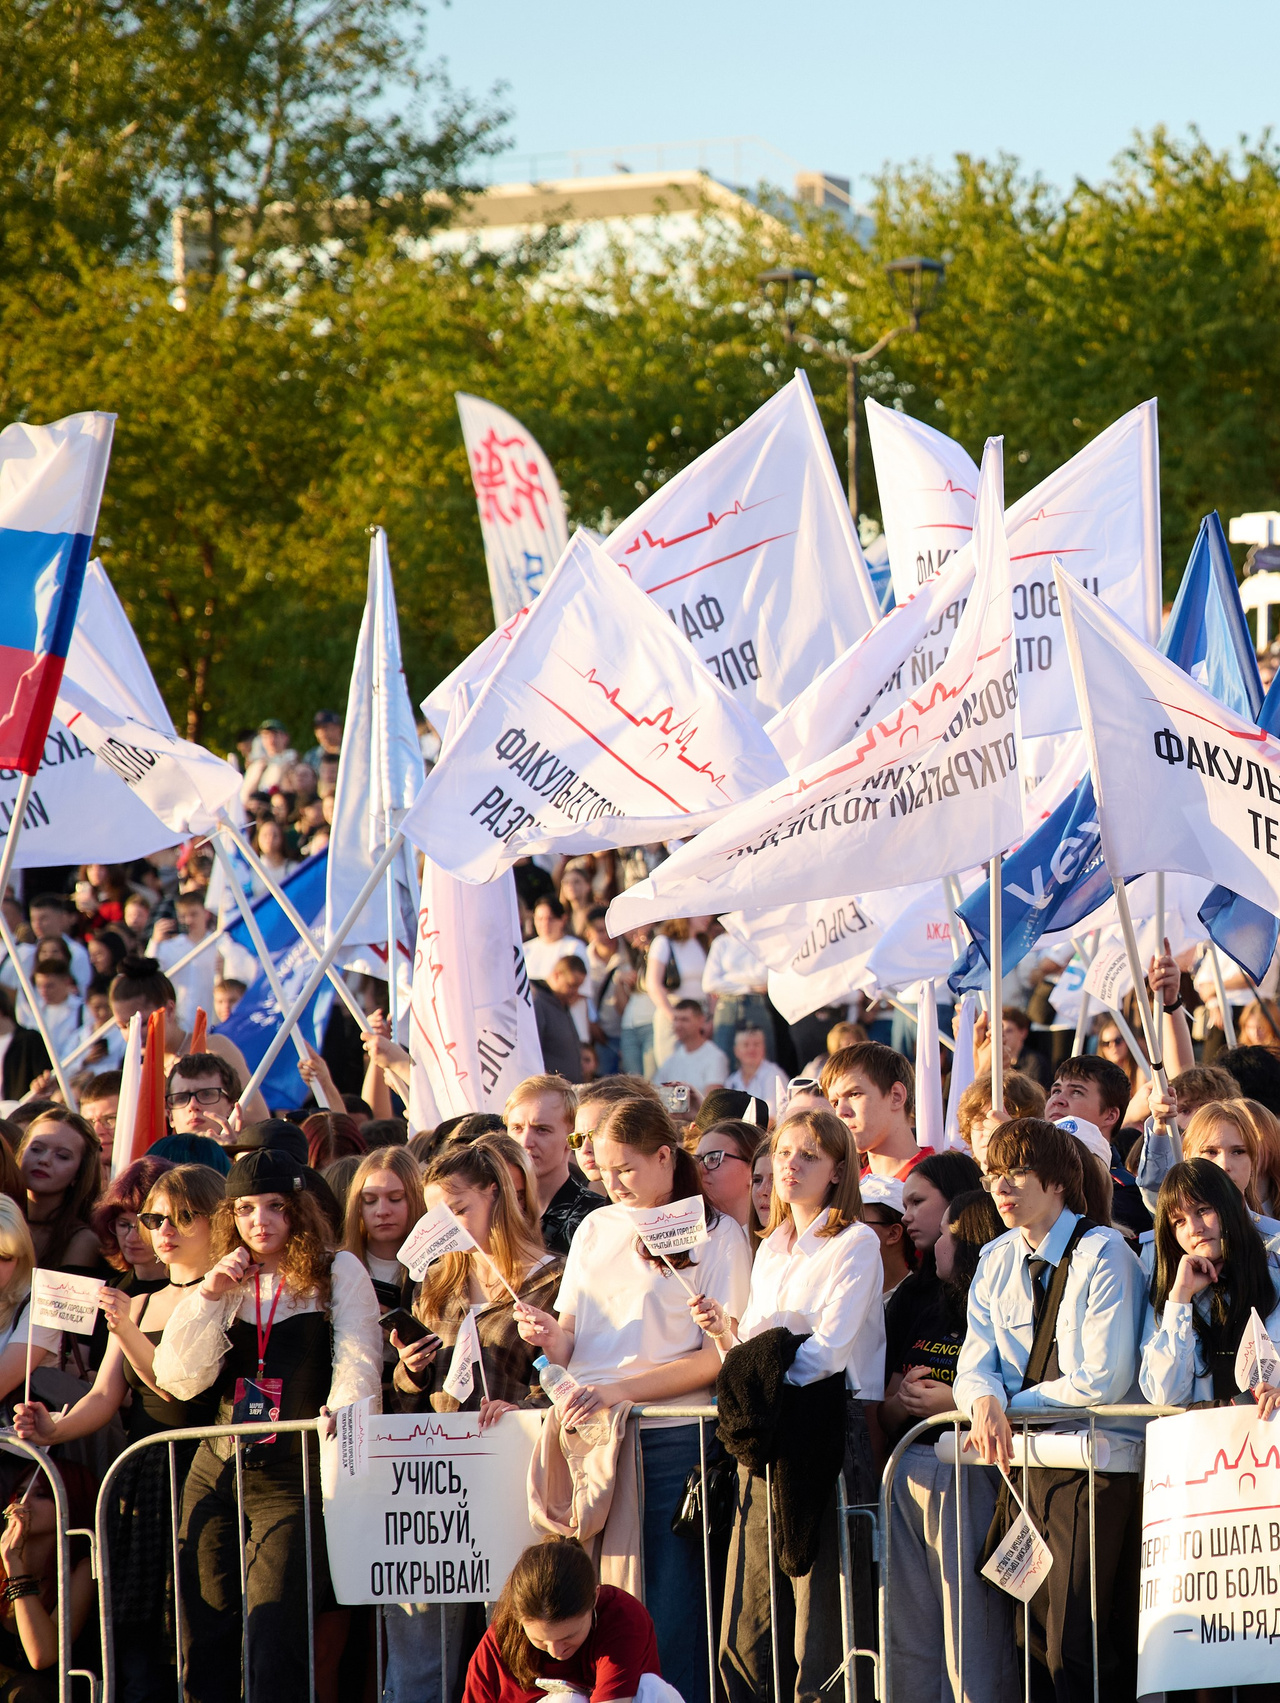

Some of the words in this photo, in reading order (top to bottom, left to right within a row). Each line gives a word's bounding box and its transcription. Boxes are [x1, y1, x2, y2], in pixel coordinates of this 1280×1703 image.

[391, 1460, 468, 1499] УЧИСЬ,
[384, 1502, 476, 1550] ПРОБУЙ,
[1210, 1524, 1263, 1557] ШАГА
[1269, 1522, 1280, 1552] В
[370, 1551, 491, 1597] ОТКРЫВАЙ!
[1200, 1611, 1235, 1644] МЫ
